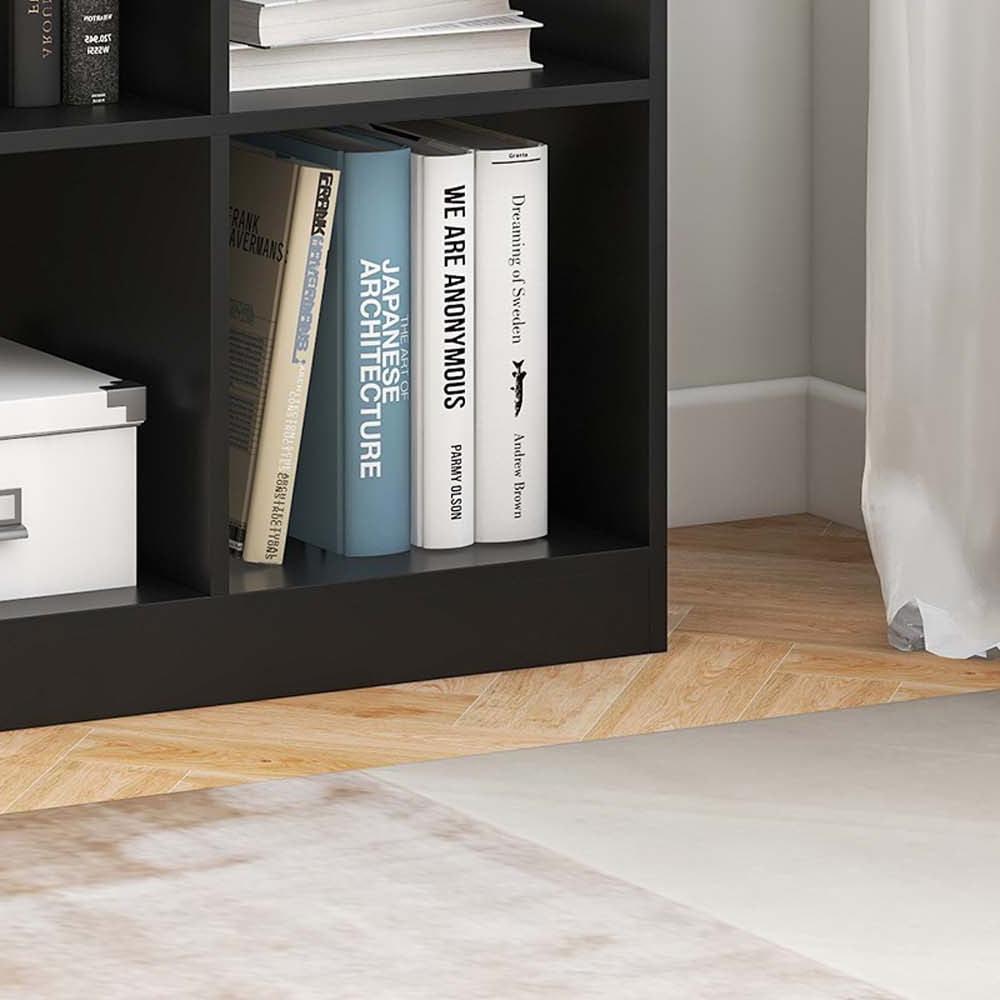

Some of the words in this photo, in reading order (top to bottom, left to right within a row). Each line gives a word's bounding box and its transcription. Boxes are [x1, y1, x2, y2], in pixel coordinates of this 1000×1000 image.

[444, 185, 466, 219] WE
[444, 225, 466, 268] ARE
[509, 194, 527, 266] Dreaming
[511, 269, 526, 286] of
[381, 258, 401, 404] JAPANESE
[400, 313, 409, 345] THE
[511, 287, 526, 344] Sweden
[444, 273, 466, 410] ANONYMOUS
[359, 258, 382, 479] ARCHITECTURE
[400, 348, 409, 377] ART
[400, 380, 409, 401] OF
[450, 444, 463, 482] PARMY
[513, 433, 526, 478] Andrew
[450, 485, 463, 521] OLSON
[513, 481, 526, 519] Brown
